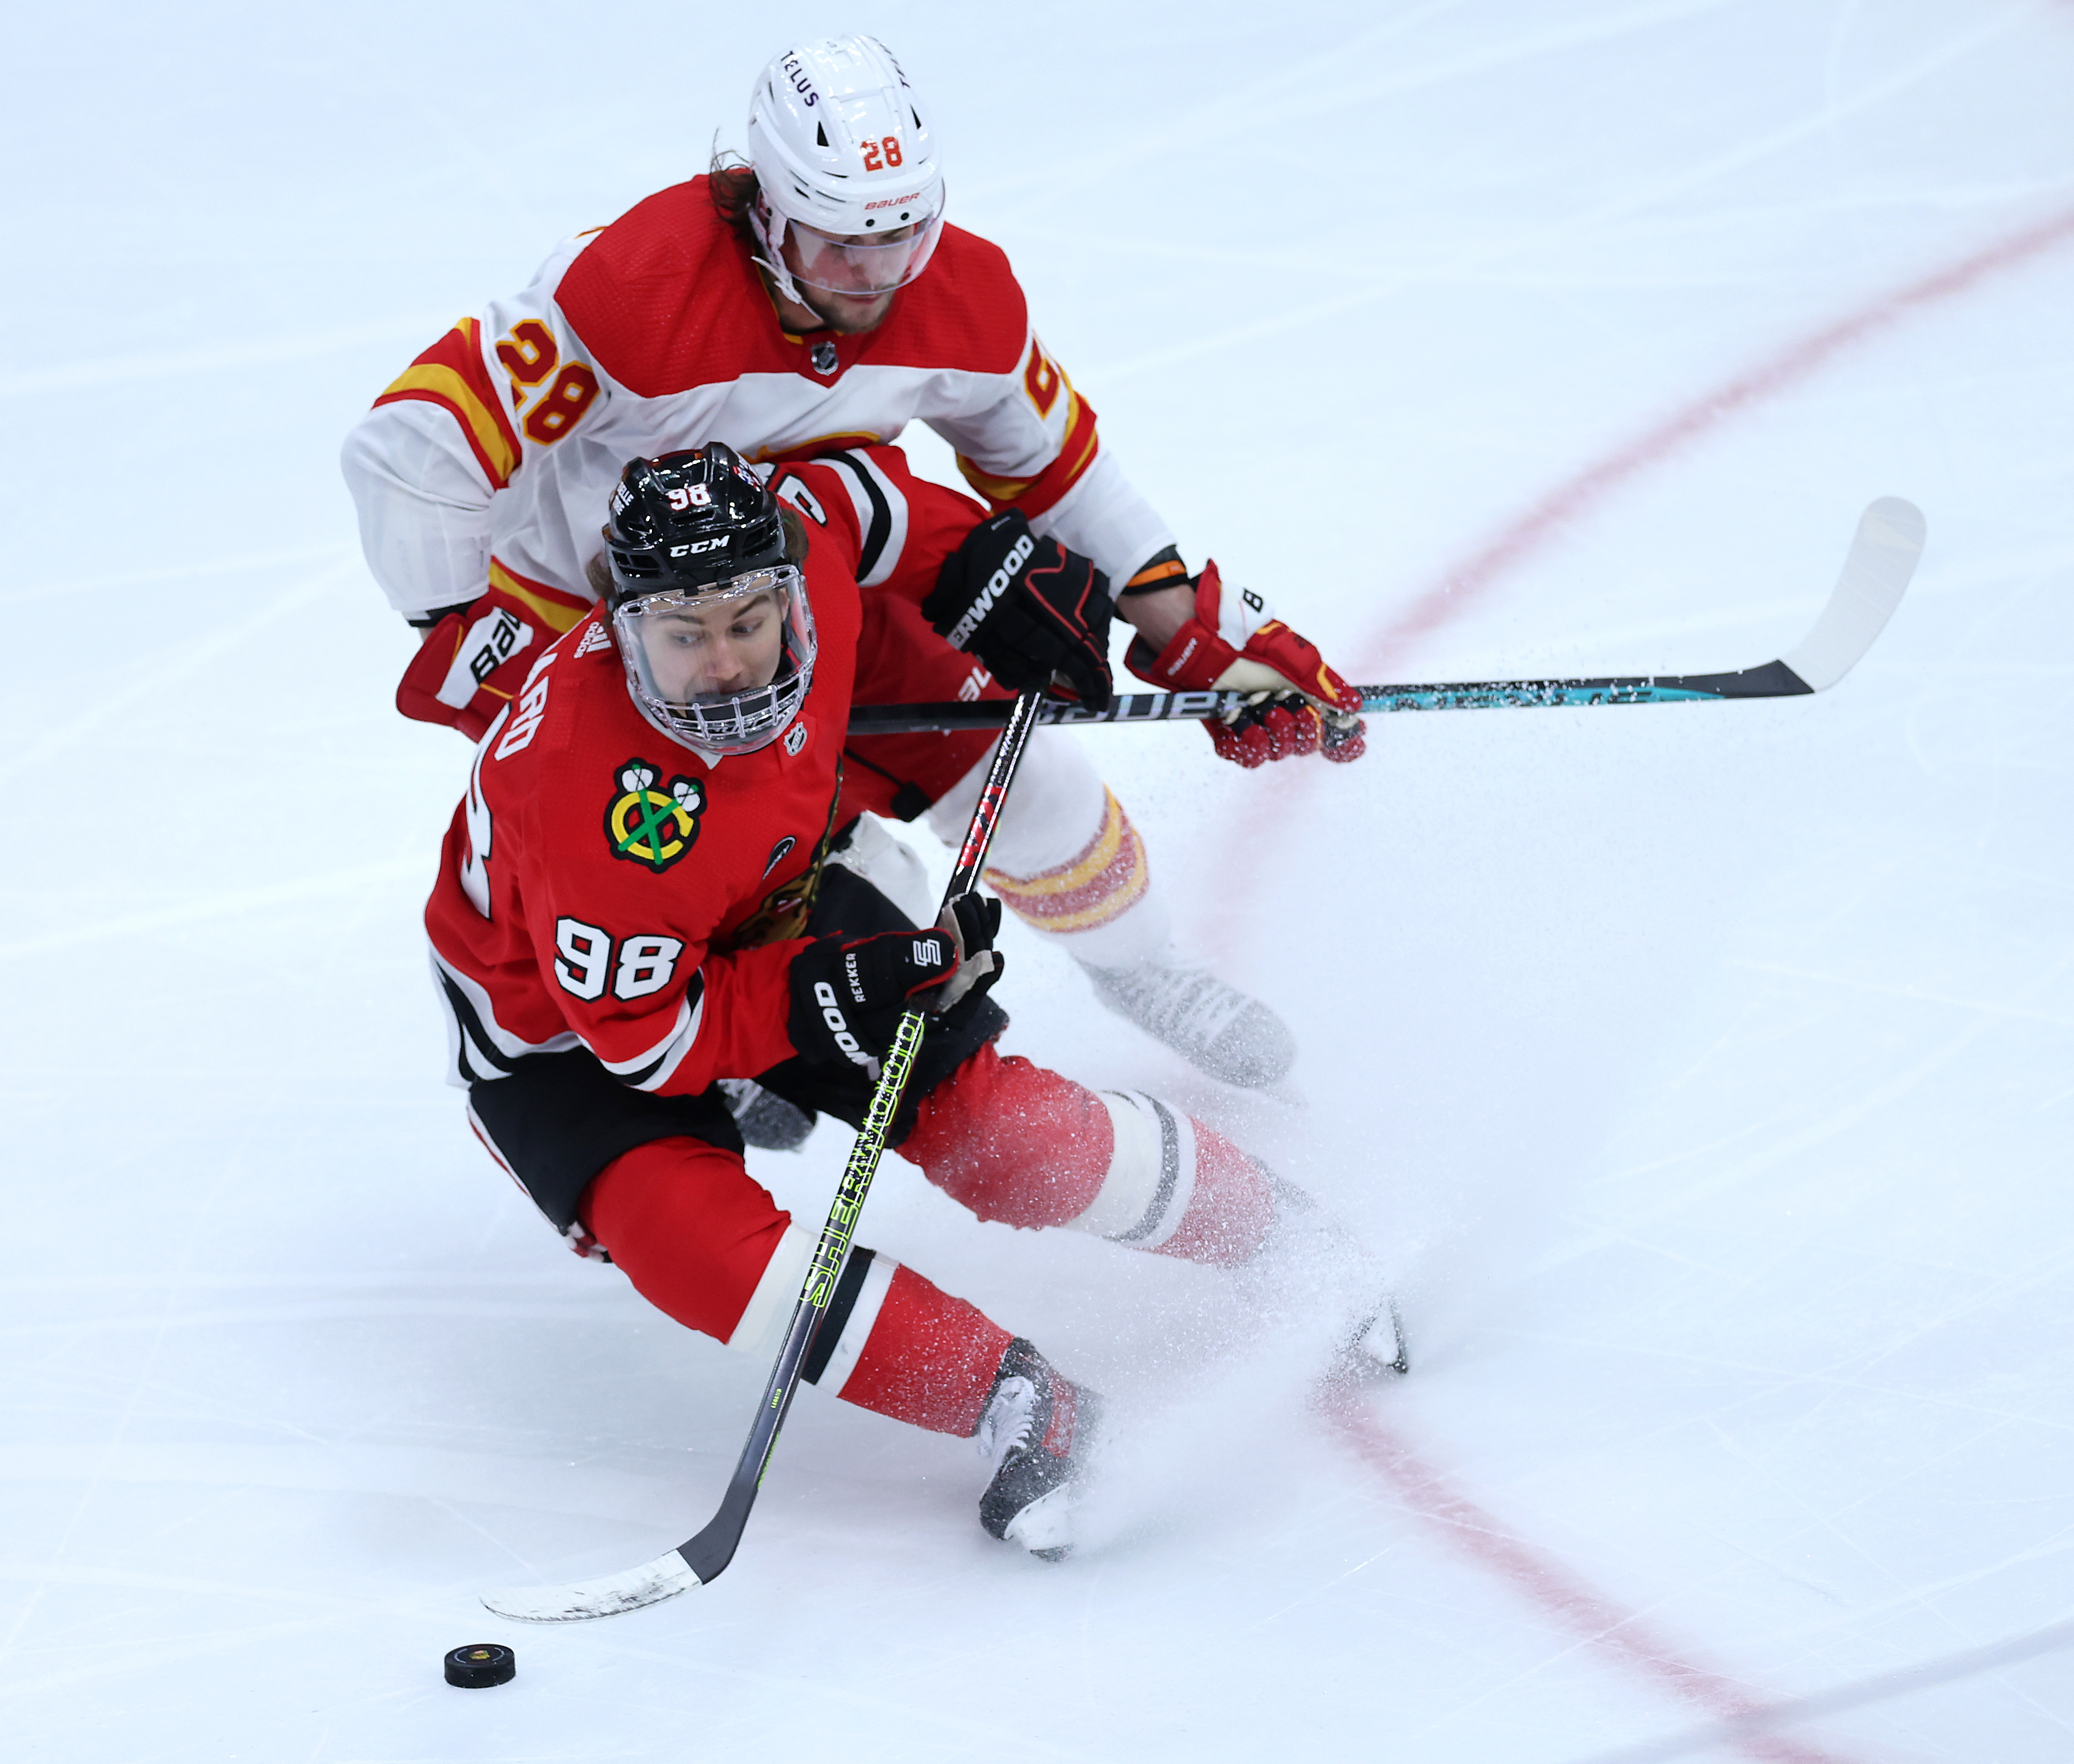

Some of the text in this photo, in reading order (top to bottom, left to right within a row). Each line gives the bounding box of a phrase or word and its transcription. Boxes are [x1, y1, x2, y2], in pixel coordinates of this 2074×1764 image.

[780, 50, 820, 107] TELUS
[860, 136, 903, 172] 28
[864, 191, 920, 210] BAUER
[494, 318, 601, 447] 28
[667, 483, 711, 511] 98
[669, 534, 731, 558] CCM
[554, 915, 685, 1002] 98
[845, 953, 866, 1002] REKKER
[799, 1010, 925, 1308] SHERWOOD
